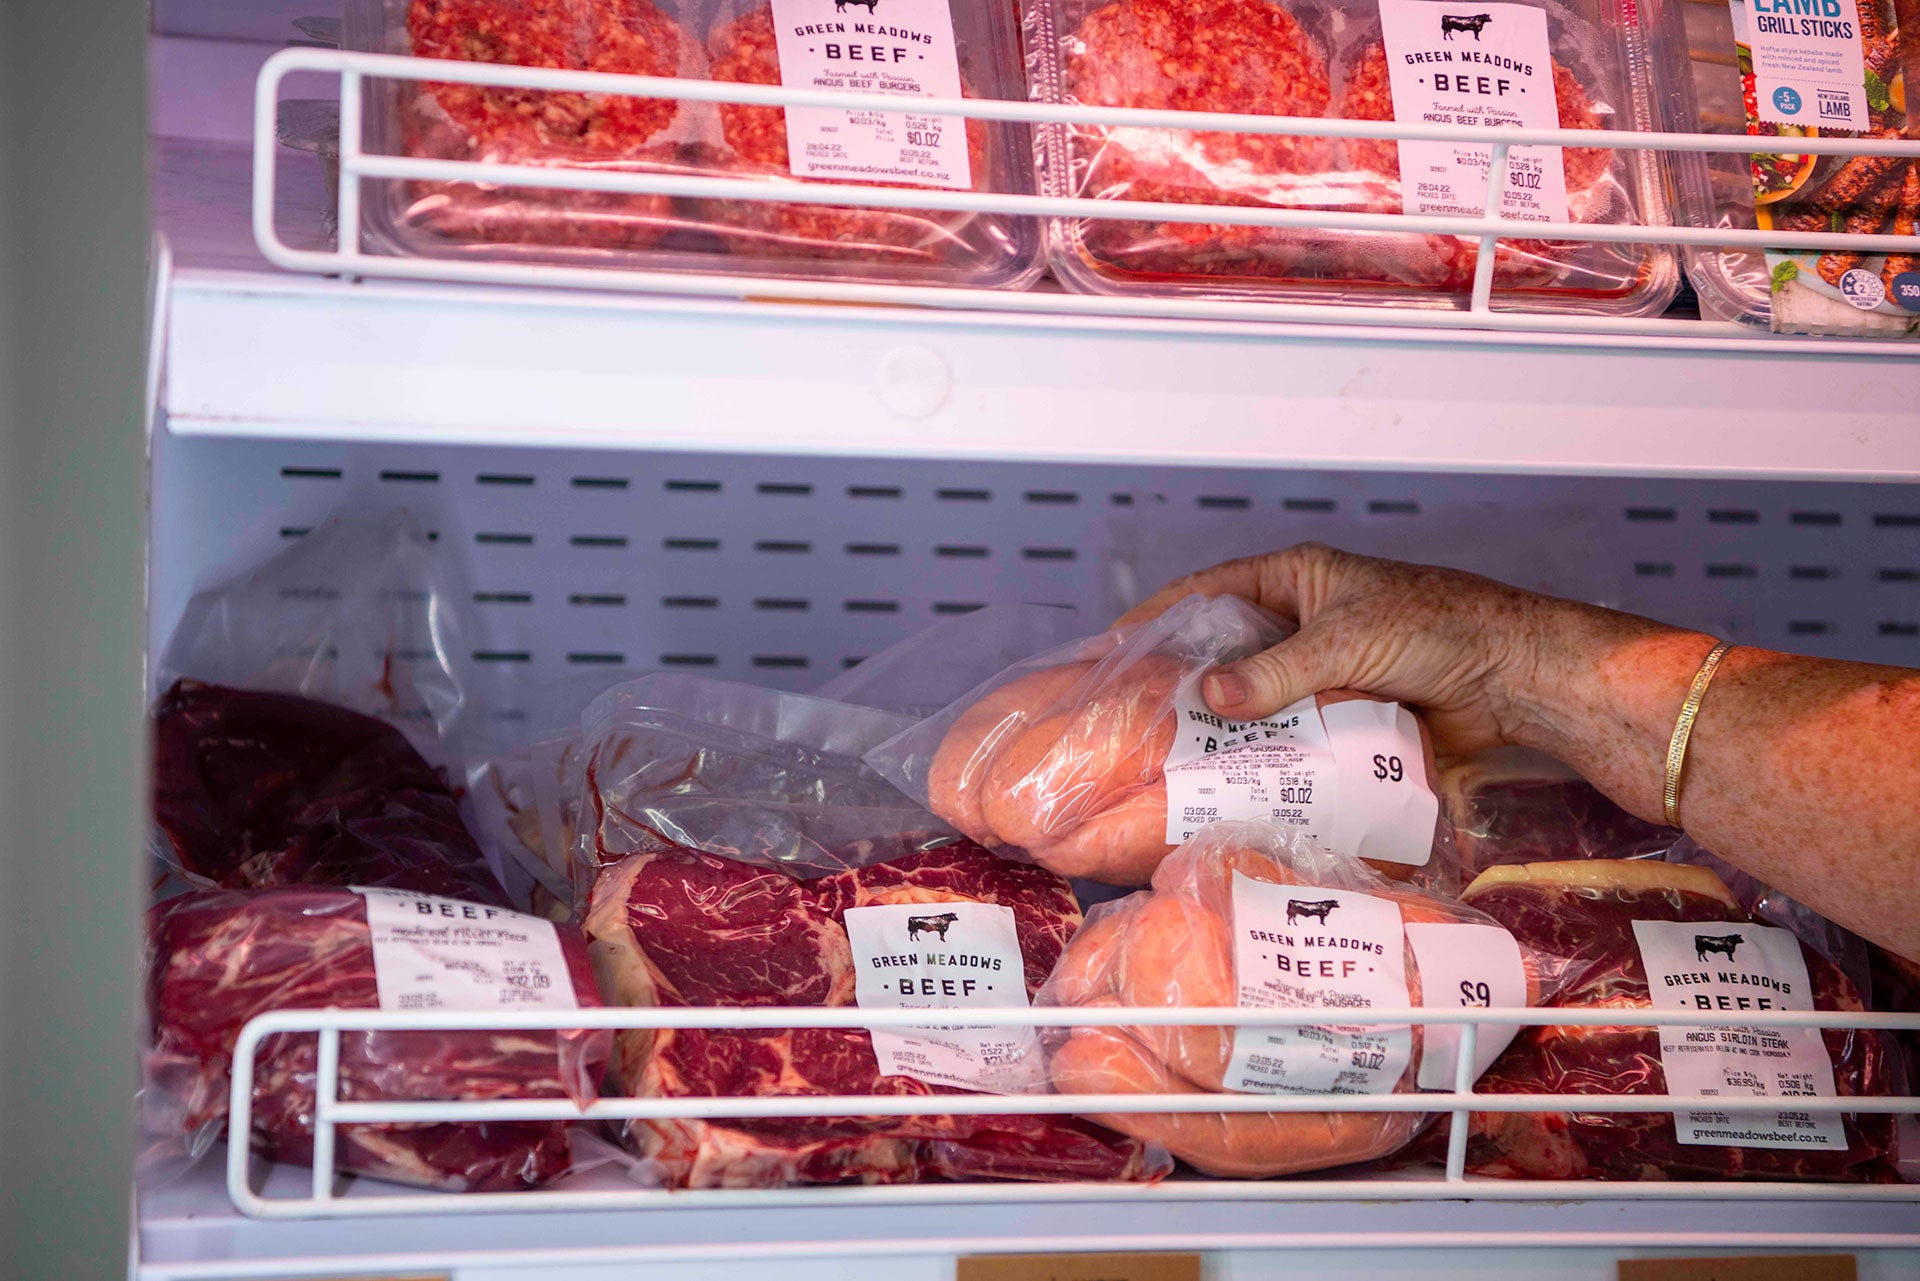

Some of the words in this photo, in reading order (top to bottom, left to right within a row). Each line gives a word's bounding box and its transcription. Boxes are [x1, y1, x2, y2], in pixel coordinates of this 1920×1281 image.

[1754, 0, 1841, 17] LAMB
[795, 23, 845, 36] GREEN
[855, 23, 932, 44] MEADOWS
[1757, 16, 1799, 35] GRILL
[1801, 19, 1853, 39] STICKS
[825, 44, 907, 63] BEEF
[1760, 45, 1780, 53] Kofta
[1781, 47, 1798, 55] style
[1799, 47, 1823, 56] kebabs
[1405, 51, 1453, 65] GREEN
[1461, 51, 1533, 77] MEADOWS
[1778, 54, 1802, 62] minced
[1818, 58, 1839, 66] spiced
[824, 69, 857, 78] Farmed
[882, 72, 914, 82] Passion
[813, 78, 843, 87] ANGUS
[849, 79, 873, 88] BEEF
[880, 81, 921, 92] BURGERS
[1434, 73, 1510, 96] BEEF
[1433, 102, 1465, 113] Farmed
[1467, 106, 1484, 114] with
[1487, 106, 1518, 117] Passion
[1780, 102, 1795, 110] PACK
[1819, 101, 1850, 117] LAMB
[1423, 113, 1452, 123] ANGUS
[1457, 115, 1478, 126] BEEF
[932, 125, 942, 133] kg
[907, 131, 941, 148] $0.02
[808, 161, 950, 180] greenmeadowsbeef.co.nz
[1534, 166, 1542, 174] kg
[1418, 182, 1451, 193] 28.04.22
[1510, 172, 1541, 189] $0.02
[1417, 191, 1439, 199] PACKED
[1441, 192, 1456, 200] DATE
[1504, 191, 1533, 201] 10.05.22
[1503, 199, 1517, 207] BEST
[1520, 201, 1541, 209] BEFORE
[1860, 285, 1865, 293] 2
[1188, 710, 1223, 729] GREEN
[1228, 716, 1299, 733] MEADOWS
[1372, 753, 1404, 783] $9
[1226, 777, 1261, 785] $0.03/kg
[1280, 777, 1299, 785] 0.518
[1303, 778, 1312, 786] kg
[1280, 787, 1312, 804] $0.02
[1184, 807, 1217, 816] 03.05.22
[1272, 809, 1302, 817] 13.05.22
[416, 902, 499, 920] BEEF
[1249, 930, 1295, 947] GREEN
[1304, 936, 1385, 956] MEADOWS
[871, 953, 918, 968] GREEN
[926, 953, 1002, 971] MEADOWS
[1277, 954, 1357, 978] BEEF
[899, 978, 976, 997] BEEF
[1664, 972, 1711, 987] GREEN
[1718, 972, 1791, 995] MEADOWS
[1460, 980, 1491, 1008] $9
[1322, 998, 1371, 1008] SAUSAGES
[1694, 995, 1772, 1011] BEEF
[1298, 1029, 1334, 1044] $0.03/kg
[1686, 1033, 1716, 1042] ANGUS
[1721, 1033, 1757, 1046] SIRLOIN
[1761, 1038, 1789, 1049] STEAK
[1351, 1041, 1371, 1050] 0.512
[1377, 1043, 1386, 1053] kg
[1249, 1054, 1284, 1069] 03.05.22
[1352, 1051, 1385, 1071] $0.02
[1271, 1069, 1287, 1078] DATE
[1723, 1068, 1741, 1077] Price
[1792, 1073, 1813, 1081] weight
[1727, 1078, 1765, 1090] $36.95/kg
[1779, 1080, 1801, 1089] 0.506
[1804, 1082, 1814, 1091] kg
[1778, 1112, 1810, 1121] 23.05.22
[1693, 1129, 1828, 1144] greenmeadowsbeef.co.nz
